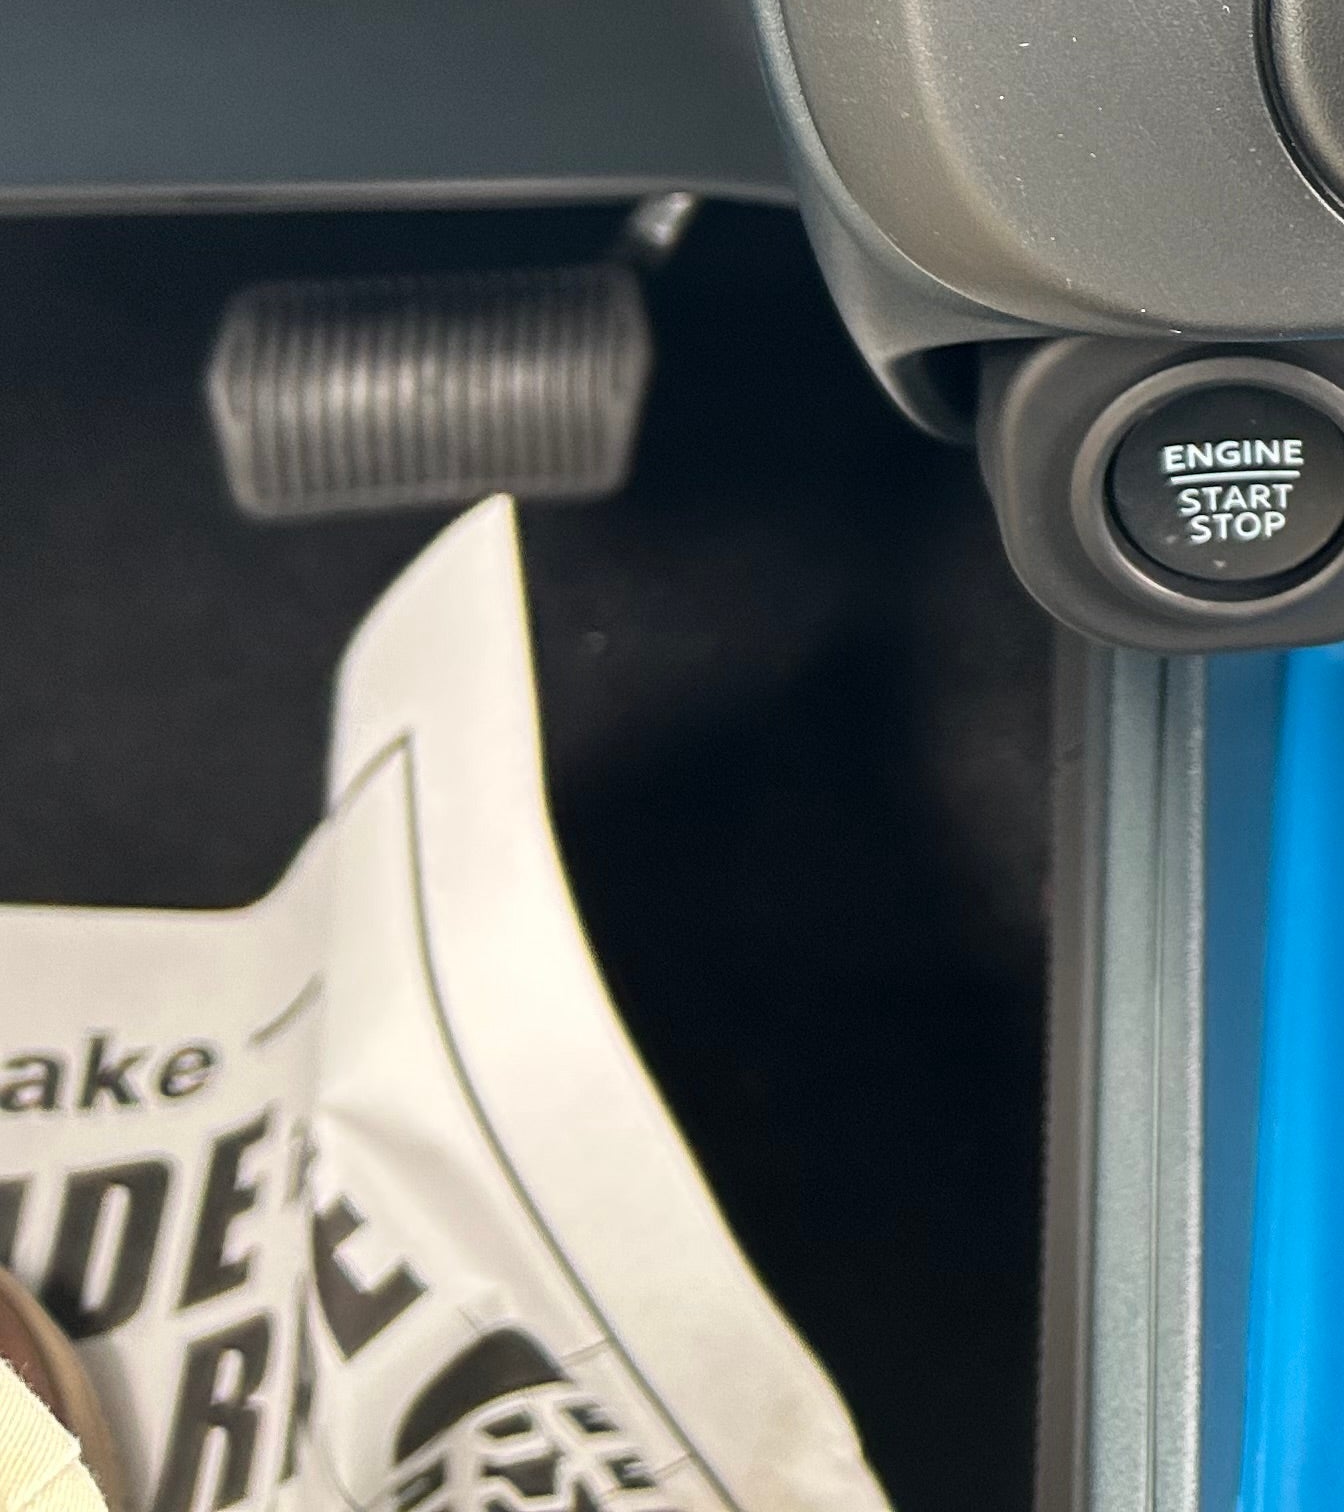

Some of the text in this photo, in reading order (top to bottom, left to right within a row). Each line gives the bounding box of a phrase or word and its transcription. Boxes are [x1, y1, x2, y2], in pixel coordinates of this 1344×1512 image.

[1162, 439, 1305, 474] ENGINE
[1178, 483, 1294, 518] START
[1189, 512, 1287, 545] STOP
